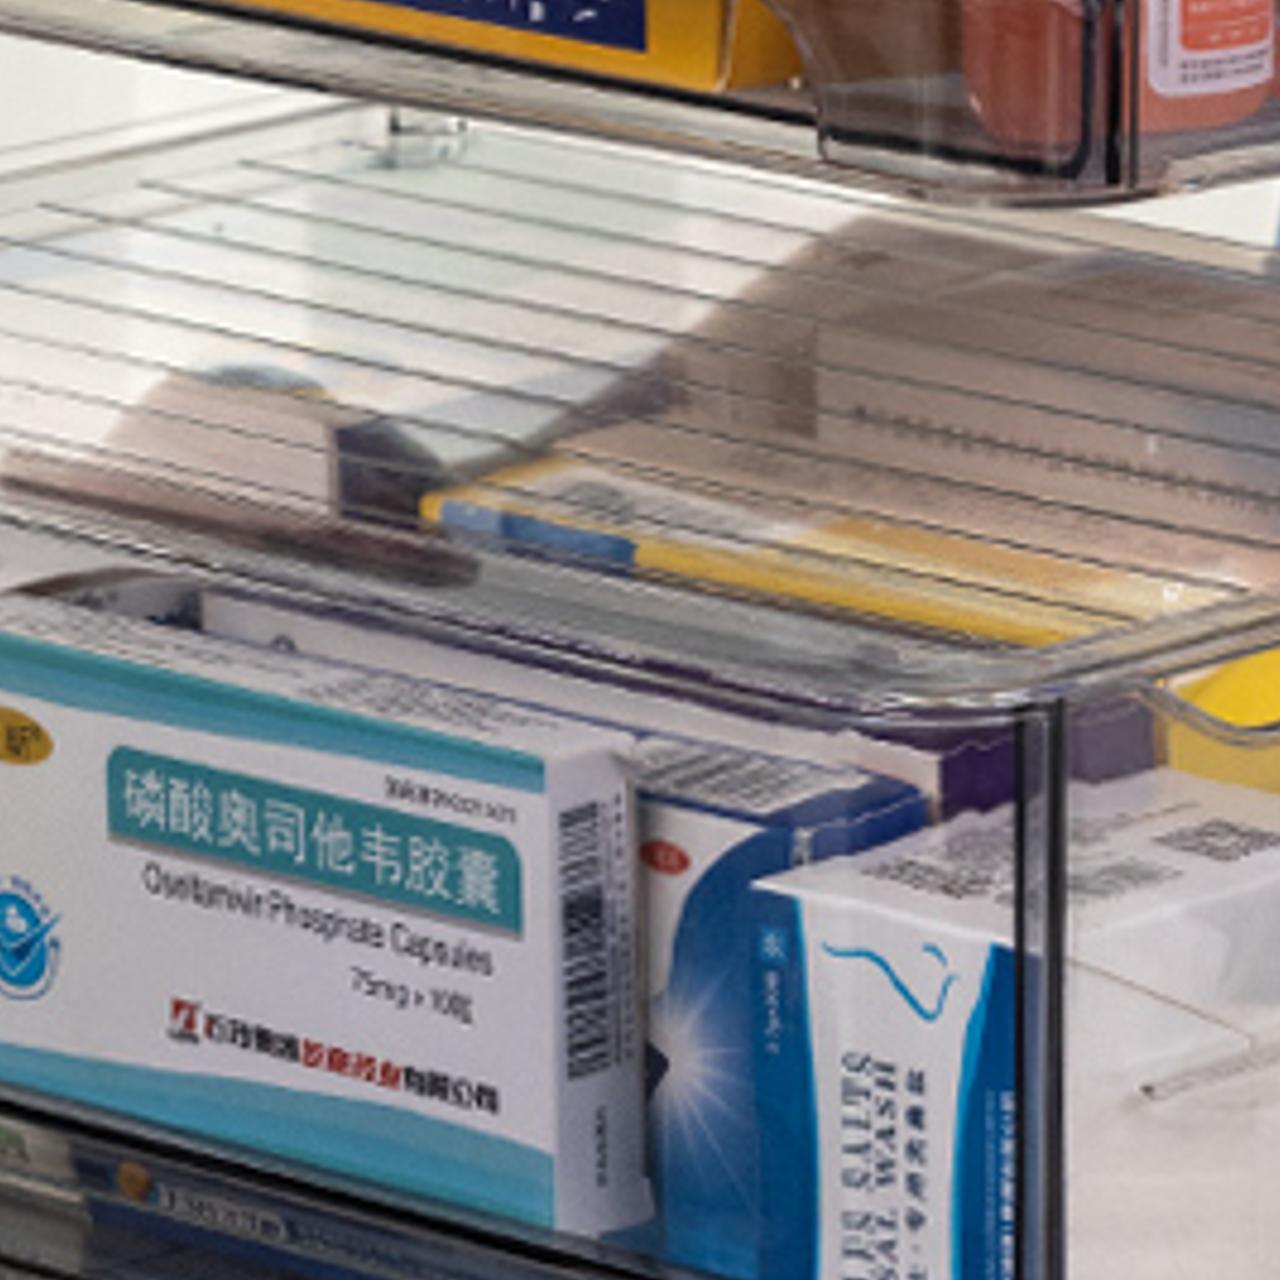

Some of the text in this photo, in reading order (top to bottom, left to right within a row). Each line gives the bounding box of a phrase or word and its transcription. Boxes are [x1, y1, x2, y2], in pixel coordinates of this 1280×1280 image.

[121, 768, 503, 915] 磷酸奥司他韦胶囊
[873, 1059, 898, 1188] WASH
